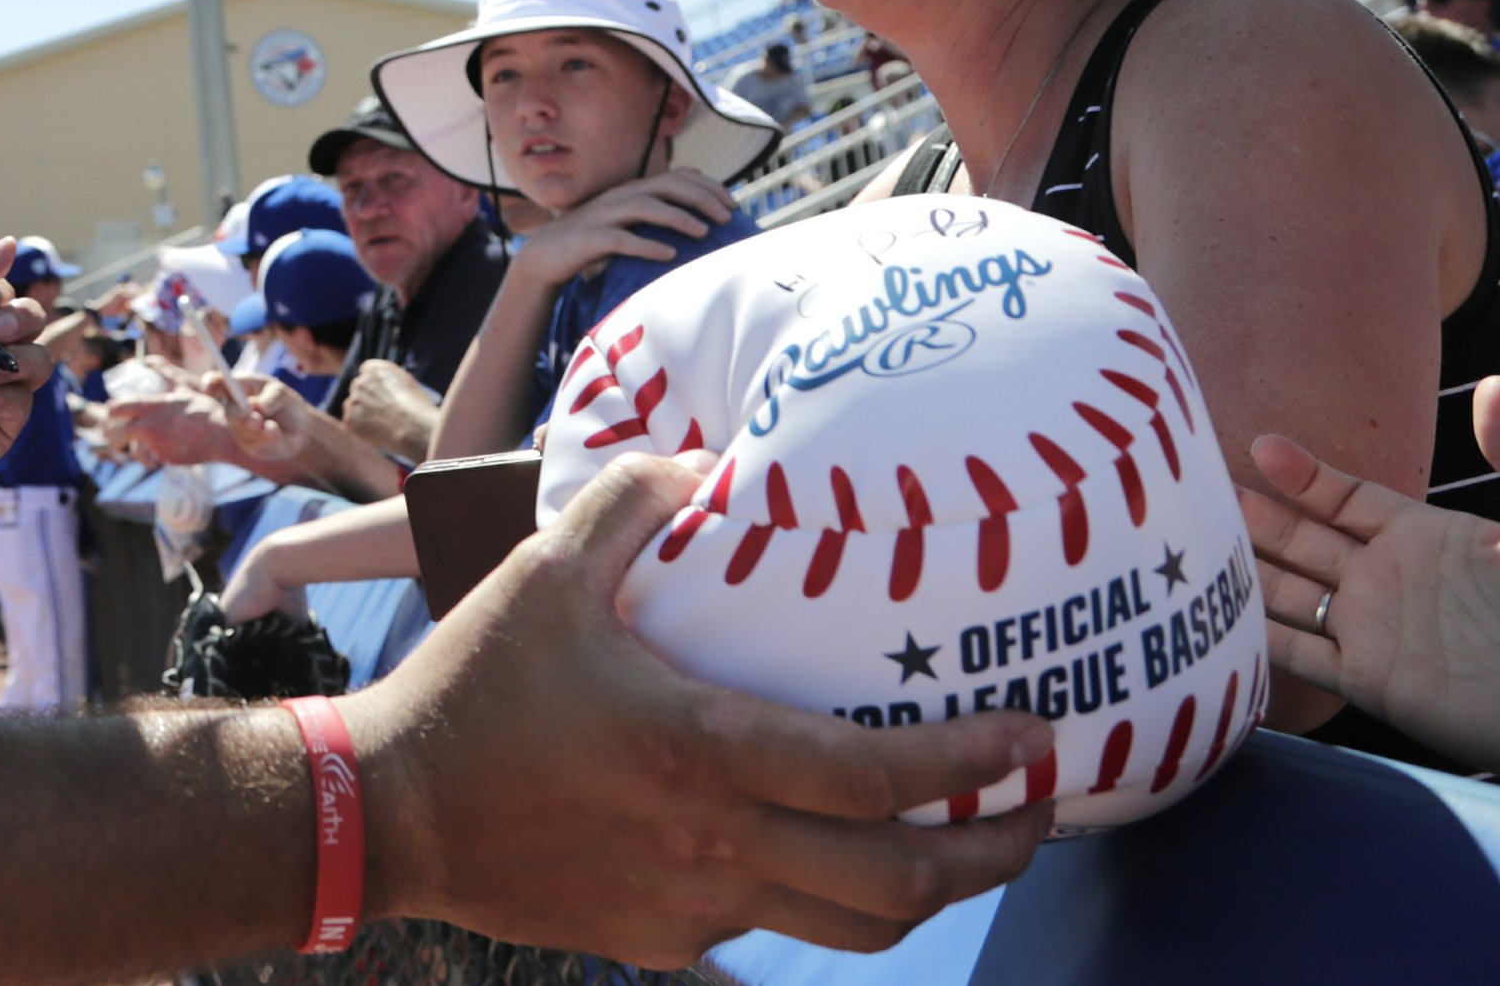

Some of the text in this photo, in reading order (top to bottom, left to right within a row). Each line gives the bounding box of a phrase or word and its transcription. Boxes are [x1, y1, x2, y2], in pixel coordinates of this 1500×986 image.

[750, 248, 1054, 437] Rawlings
[959, 568, 1152, 675] OFFICIAL
[1141, 535, 1255, 691] BASEBALL
